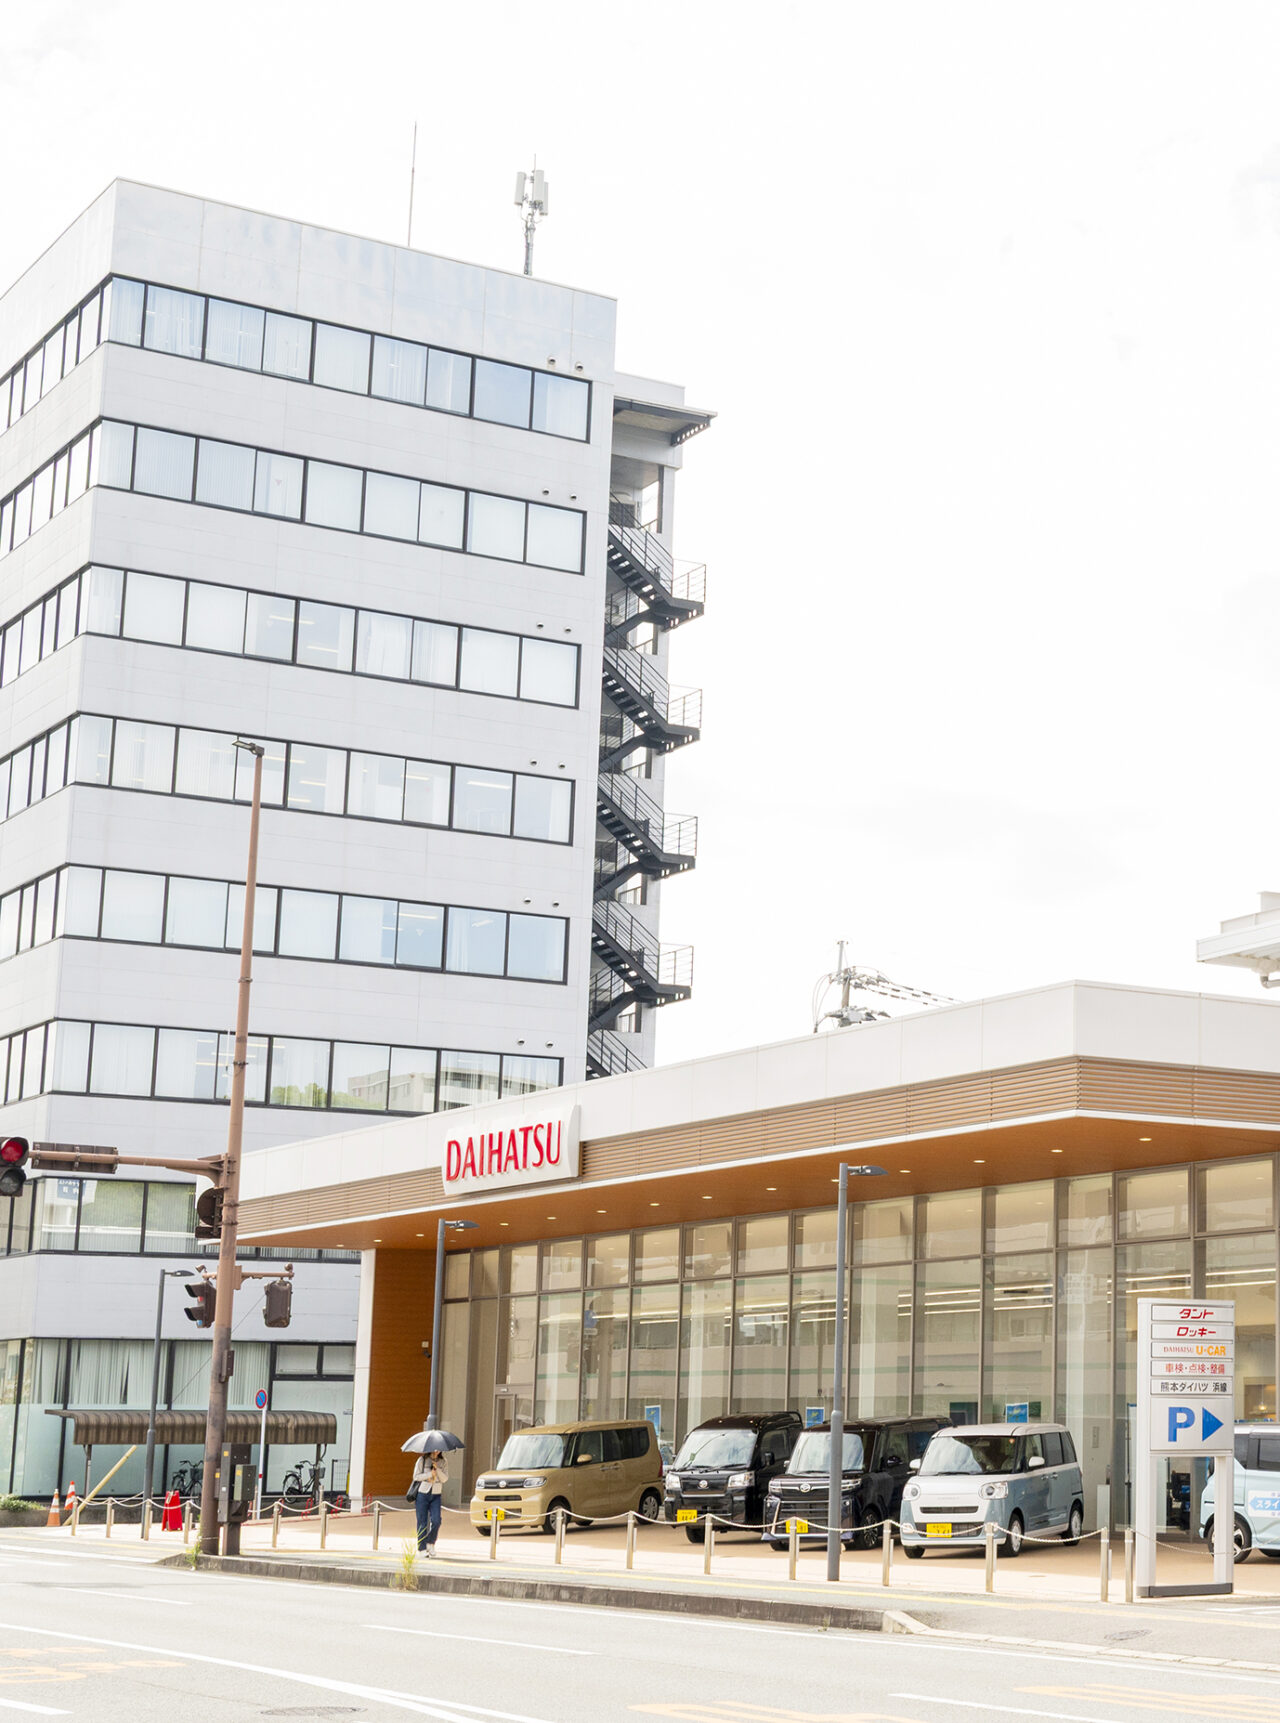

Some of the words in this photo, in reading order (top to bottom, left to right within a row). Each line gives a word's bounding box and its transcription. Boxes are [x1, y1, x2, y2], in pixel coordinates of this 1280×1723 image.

[445, 1120, 562, 1182] DAIHATSU
[1179, 1308, 1215, 1319] タント
[1176, 1326, 1217, 1338] ロッキー
[1168, 1406, 1196, 1442] P
